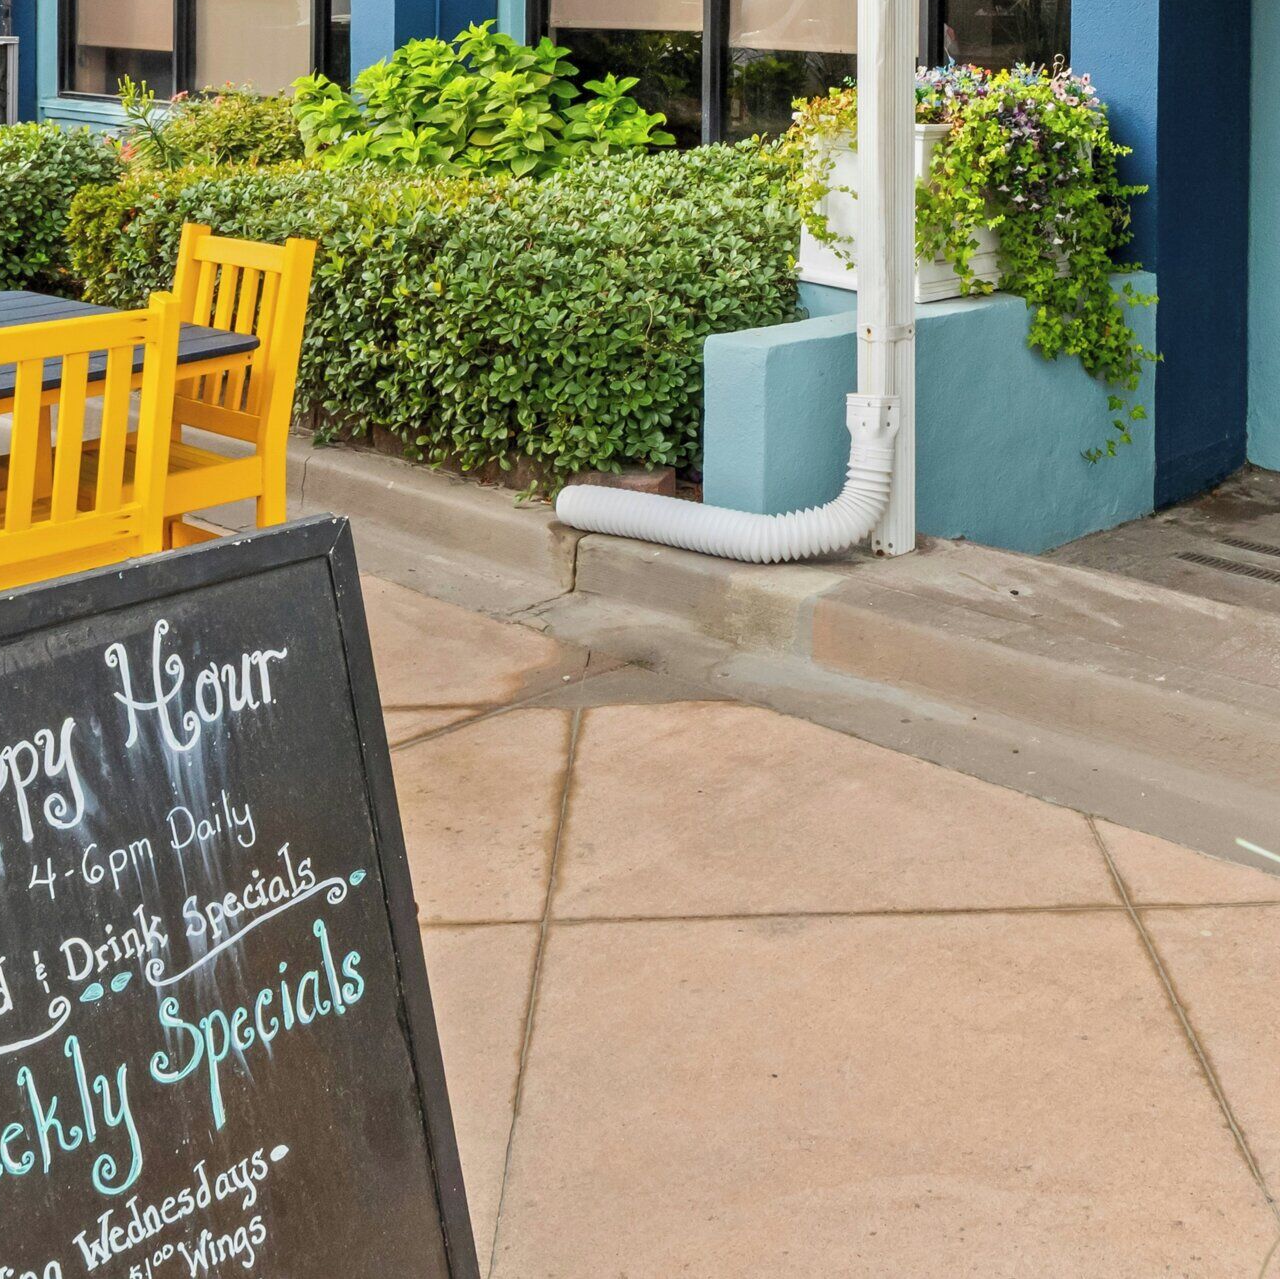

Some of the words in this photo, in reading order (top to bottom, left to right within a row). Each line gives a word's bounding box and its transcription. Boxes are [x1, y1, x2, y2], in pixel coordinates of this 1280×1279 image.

[103, 619, 288, 752] Hour
[28, 837, 154, 900] 4-6pm
[165, 788, 256, 850] Daily
[59, 904, 169, 982] Drink
[181, 842, 317, 941] Specials
[150, 919, 366, 1131] Specials
[72, 1147, 269, 1272] Wednesdays
[176, 1215, 267, 1278] Wings
